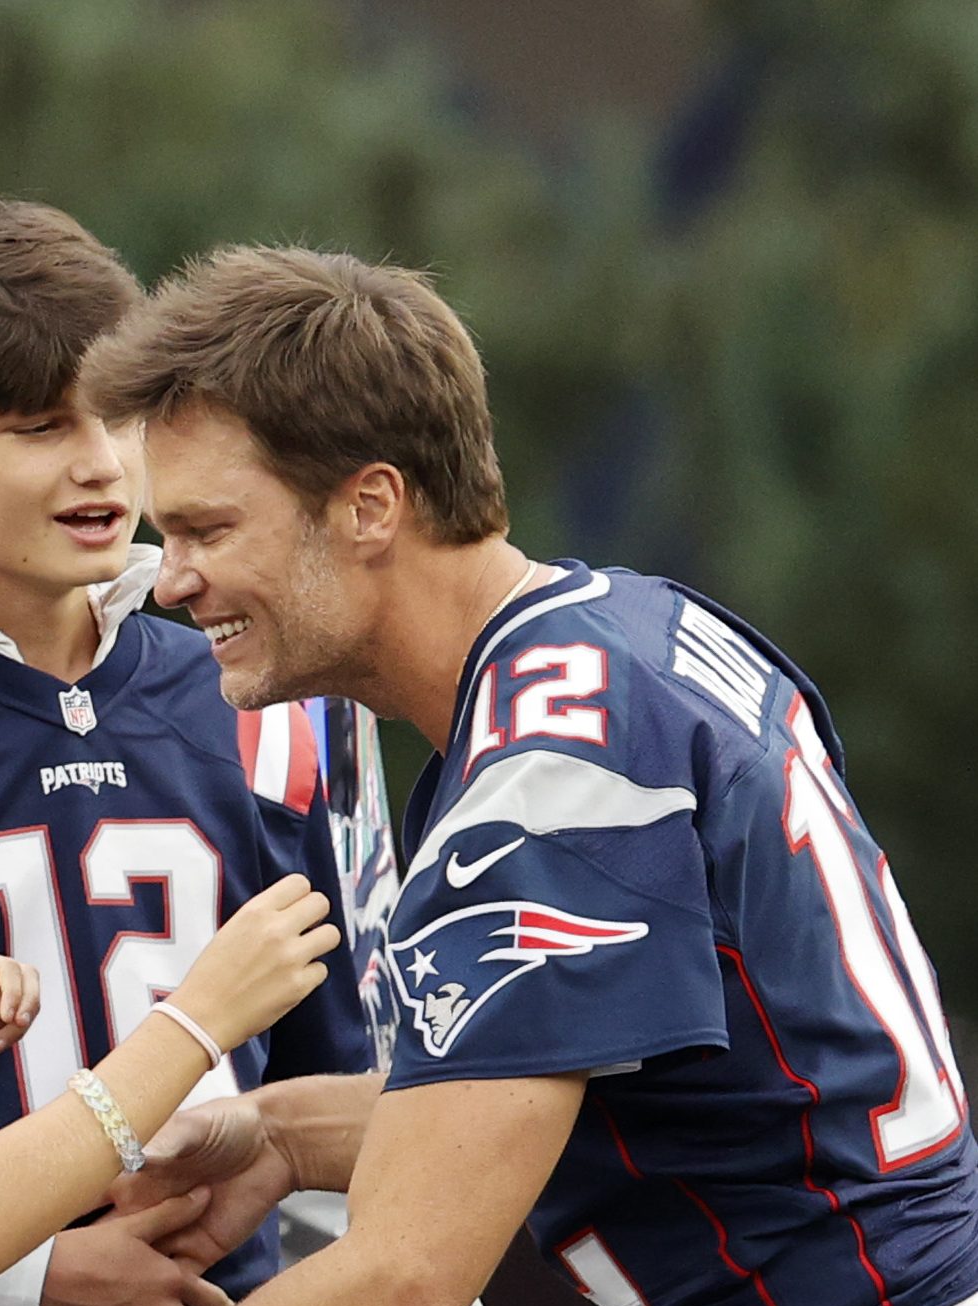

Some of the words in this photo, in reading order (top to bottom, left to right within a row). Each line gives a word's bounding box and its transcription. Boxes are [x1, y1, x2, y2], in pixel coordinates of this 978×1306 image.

[70, 708, 93, 726] NFL
[462, 641, 609, 784] 12
[40, 762, 127, 795] PATRIOTS
